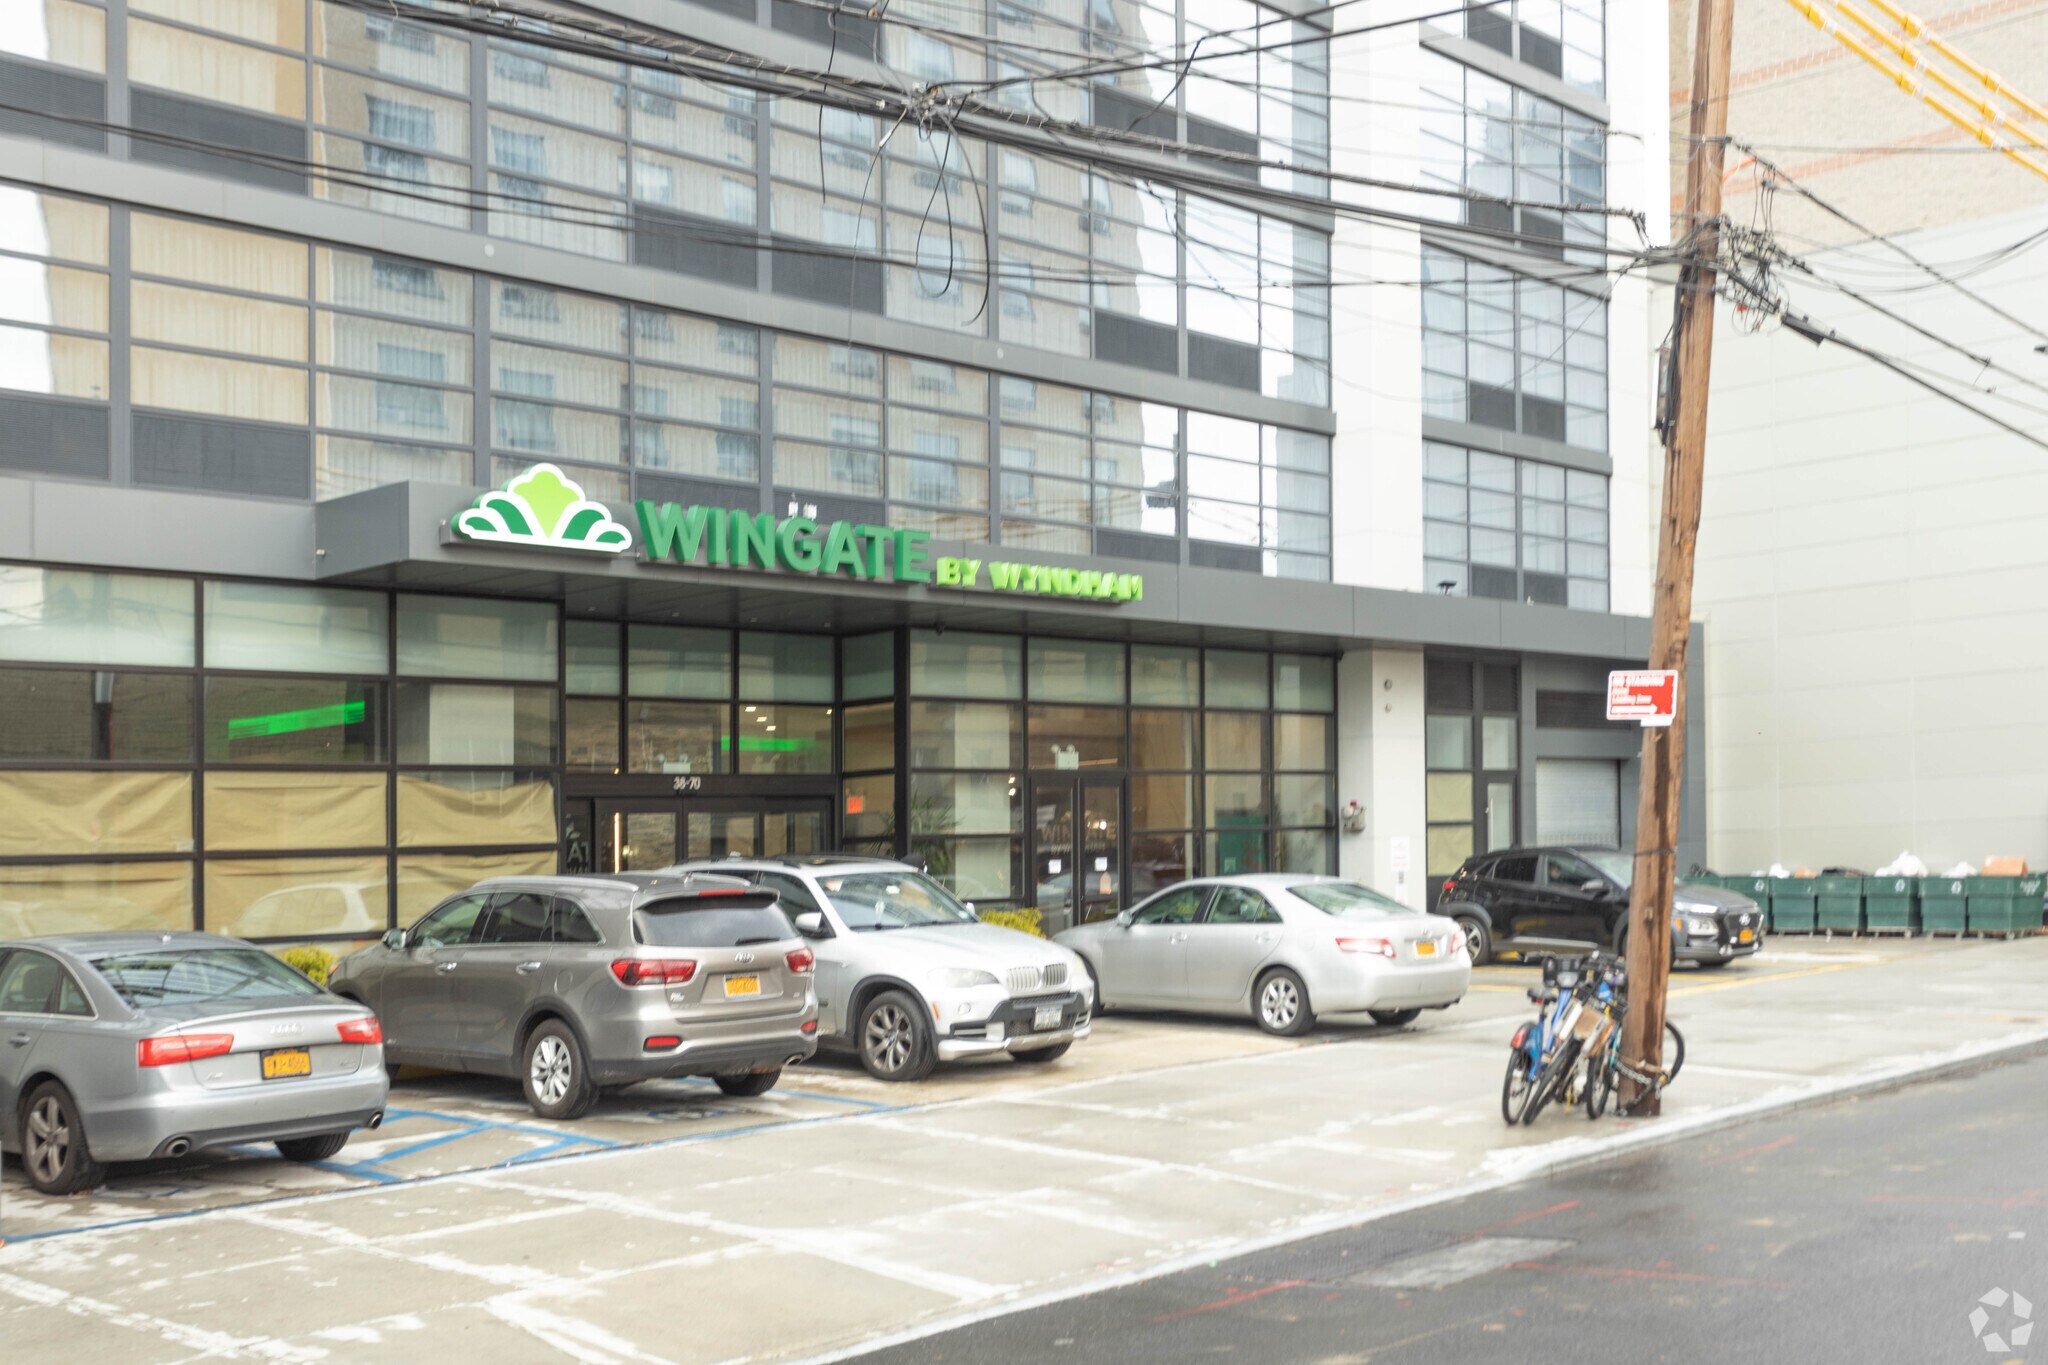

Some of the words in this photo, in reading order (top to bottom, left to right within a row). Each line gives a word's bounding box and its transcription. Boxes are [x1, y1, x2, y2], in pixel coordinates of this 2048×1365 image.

[635, 499, 931, 583] WINGATE
[936, 556, 982, 587] BY
[988, 561, 1143, 601] WYNDHAM
[673, 776, 701, 790] 38-70
